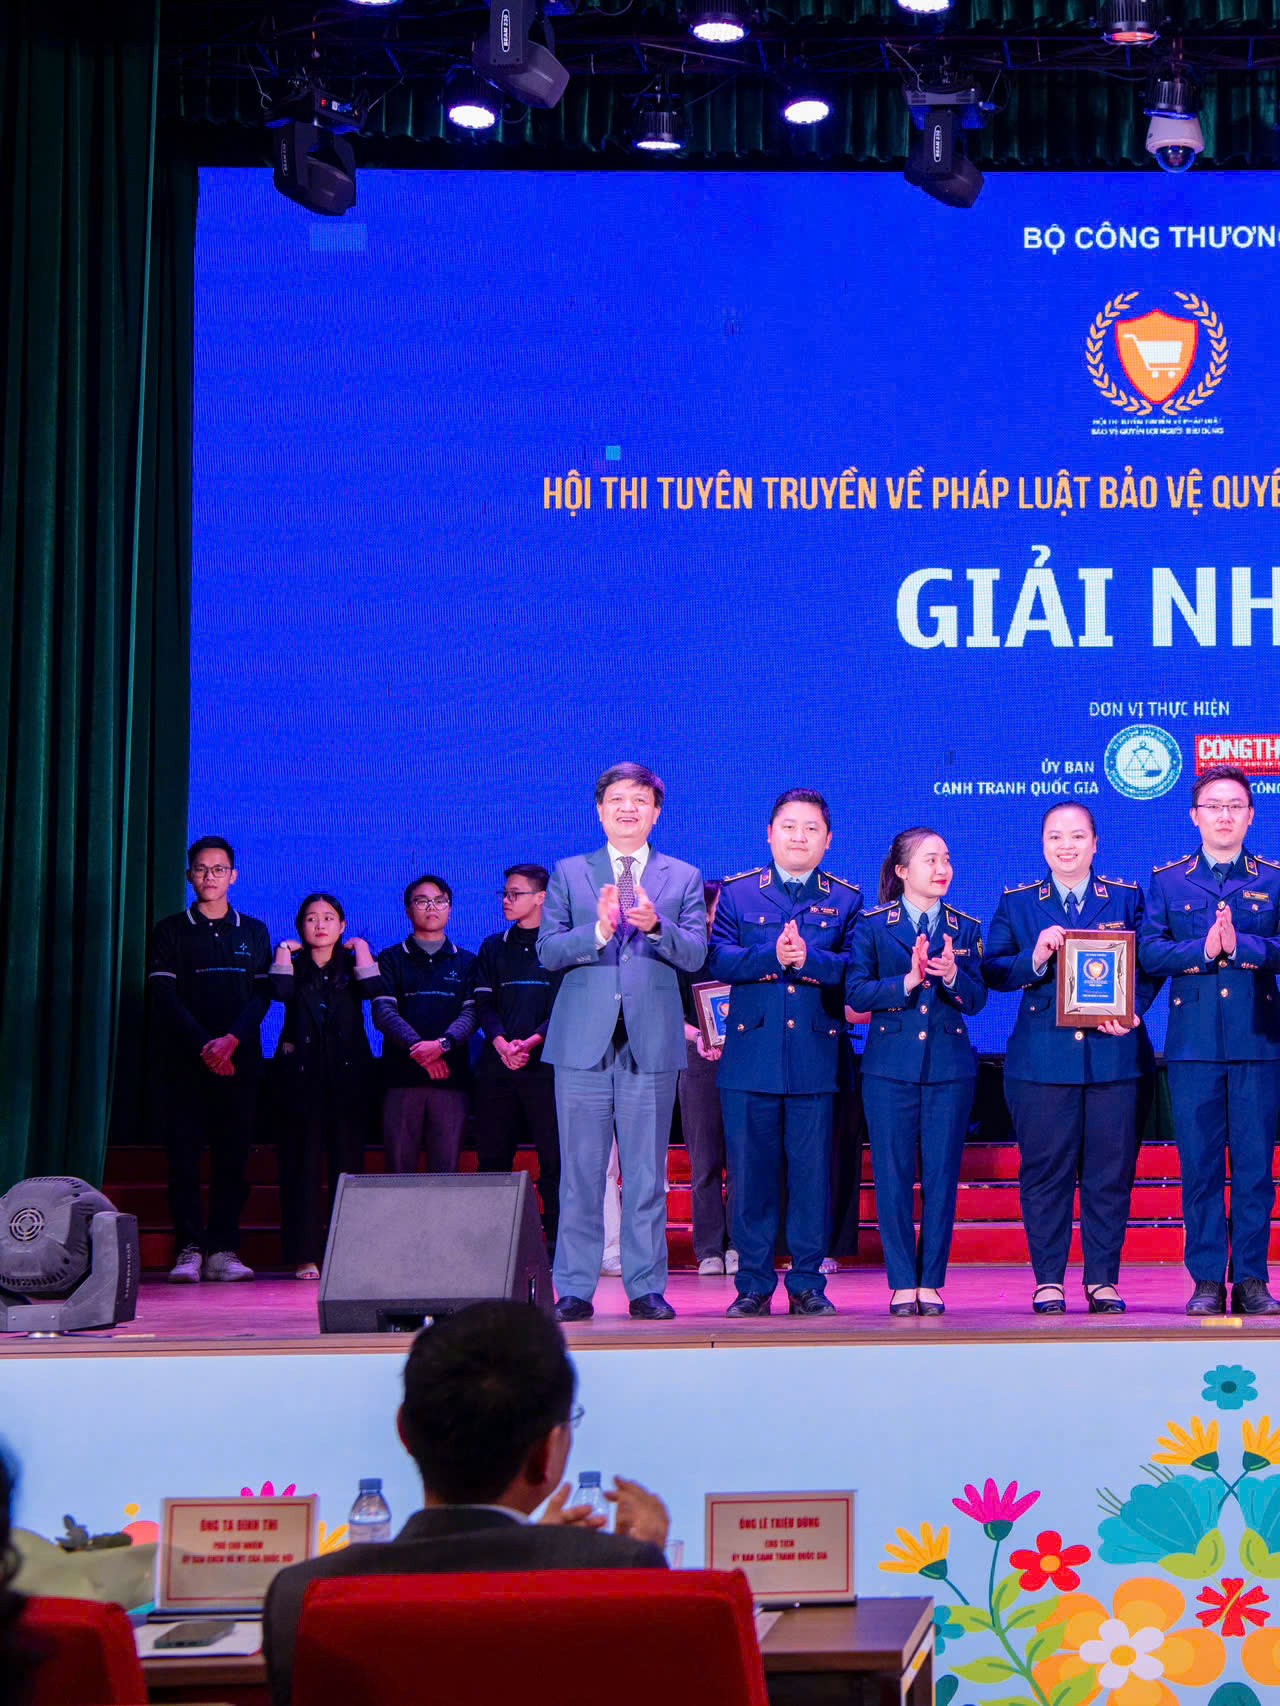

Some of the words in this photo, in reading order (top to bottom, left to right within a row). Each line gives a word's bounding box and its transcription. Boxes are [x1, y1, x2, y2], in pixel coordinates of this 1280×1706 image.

[1024, 224, 1065, 255] BỘ
[1075, 221, 1159, 249] CÔNG
[544, 470, 591, 517] HỘI
[600, 477, 647, 509] THI
[657, 470, 752, 510] TUYÊN
[762, 466, 876, 510] TRUYỀN
[886, 466, 924, 509] VỀ
[933, 470, 1009, 509] PHÁP
[1019, 469, 1091, 516] LUẬT
[1100, 466, 1157, 508] BẢO
[1166, 468, 1203, 515] VỆ
[897, 545, 1113, 649] GIẢI
[1089, 702, 1122, 716] ĐƠN
[1128, 702, 1143, 718] VỊ
[1147, 702, 1187, 718] THỰC
[1194, 699, 1229, 717] HIỆN
[1042, 758, 1060, 774] ỦY
[1065, 761, 1094, 773] BAN
[934, 782, 972, 796] CẠNH
[977, 782, 1025, 794] TRANH
[1031, 778, 1070, 796] QUỐC
[1074, 781, 1099, 794] GIA
